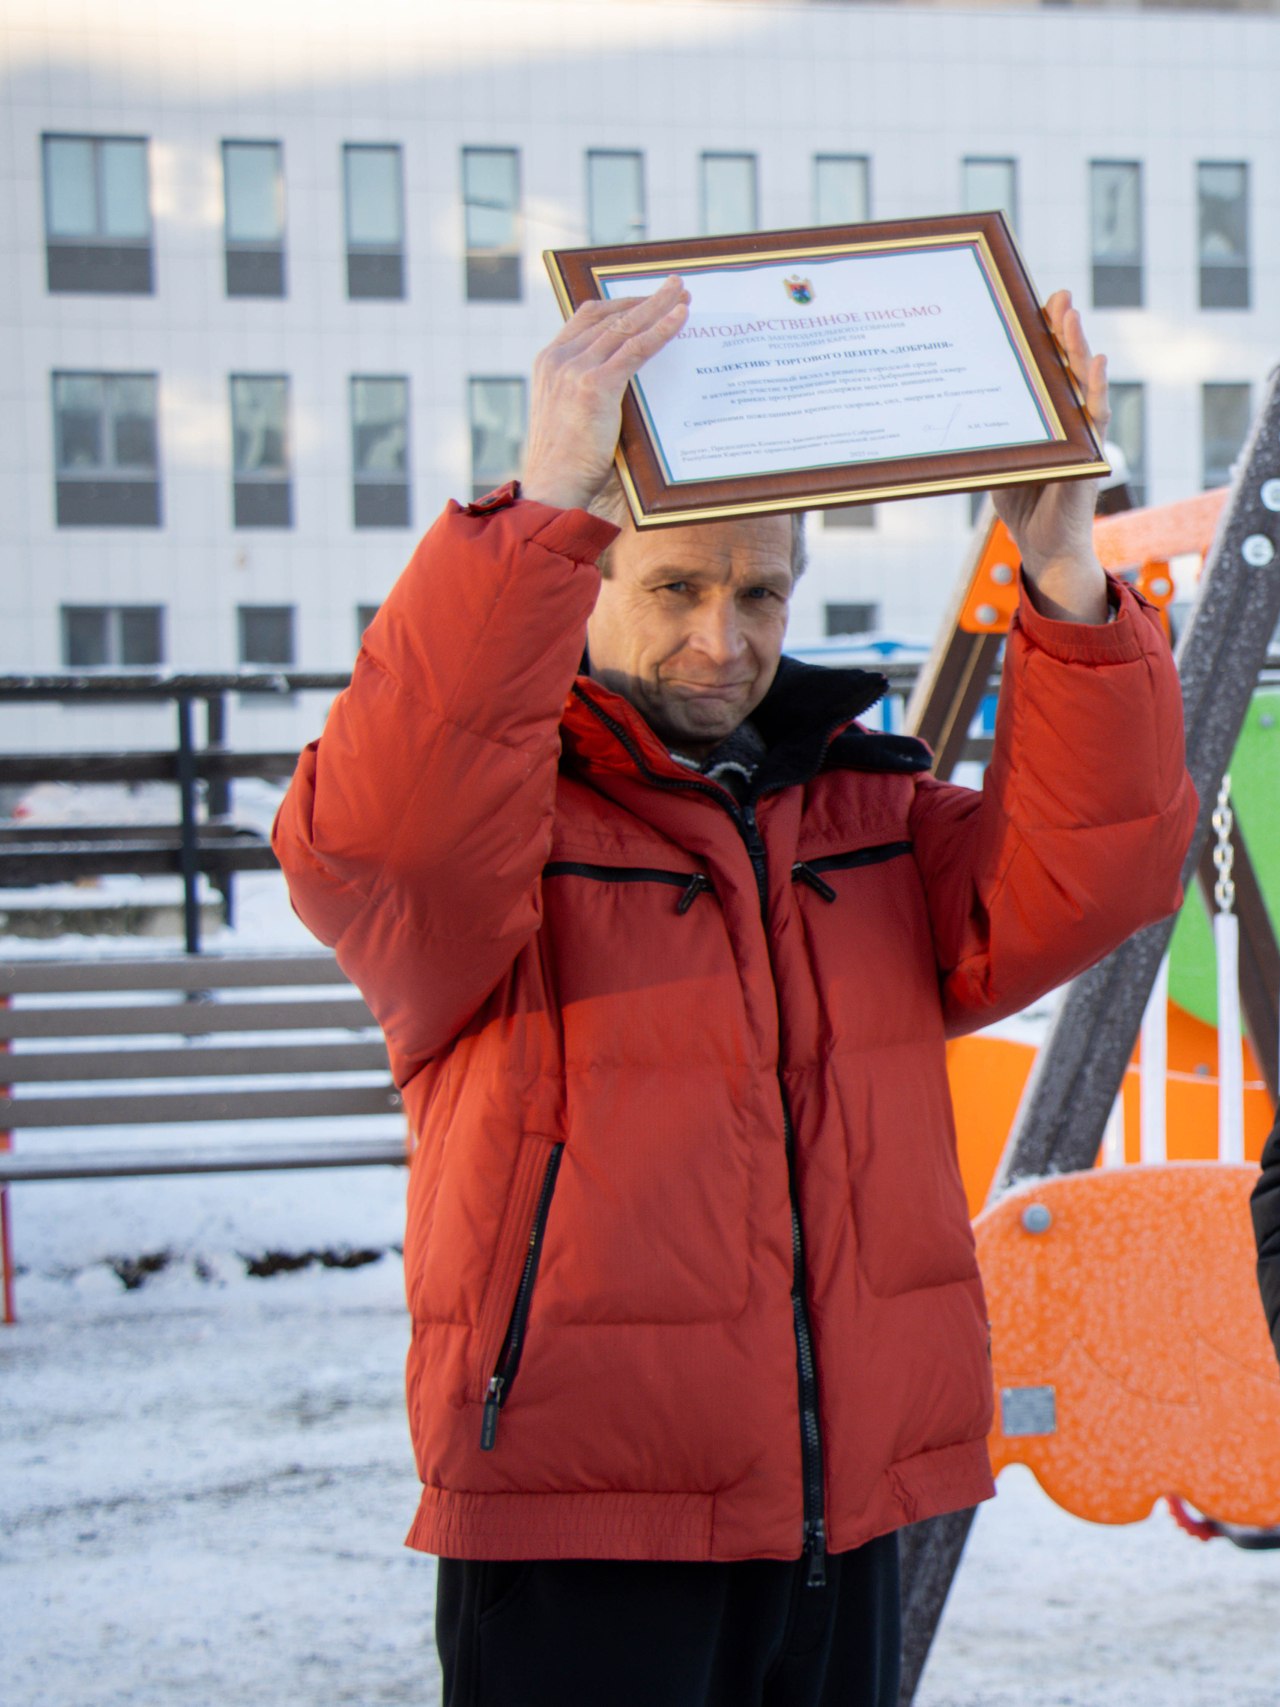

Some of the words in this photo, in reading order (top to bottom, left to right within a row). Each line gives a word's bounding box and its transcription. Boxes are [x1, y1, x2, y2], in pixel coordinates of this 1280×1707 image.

[675, 312, 861, 339] БЛАГОДАРСТВЕННОЕ
[864, 304, 941, 321] ПИСЬМО
[696, 360, 770, 374] КОЛЛЕКТИВУ
[775, 352, 841, 366] ТОРГОВОГО
[843, 348, 887, 357] ЦЕНТРА
